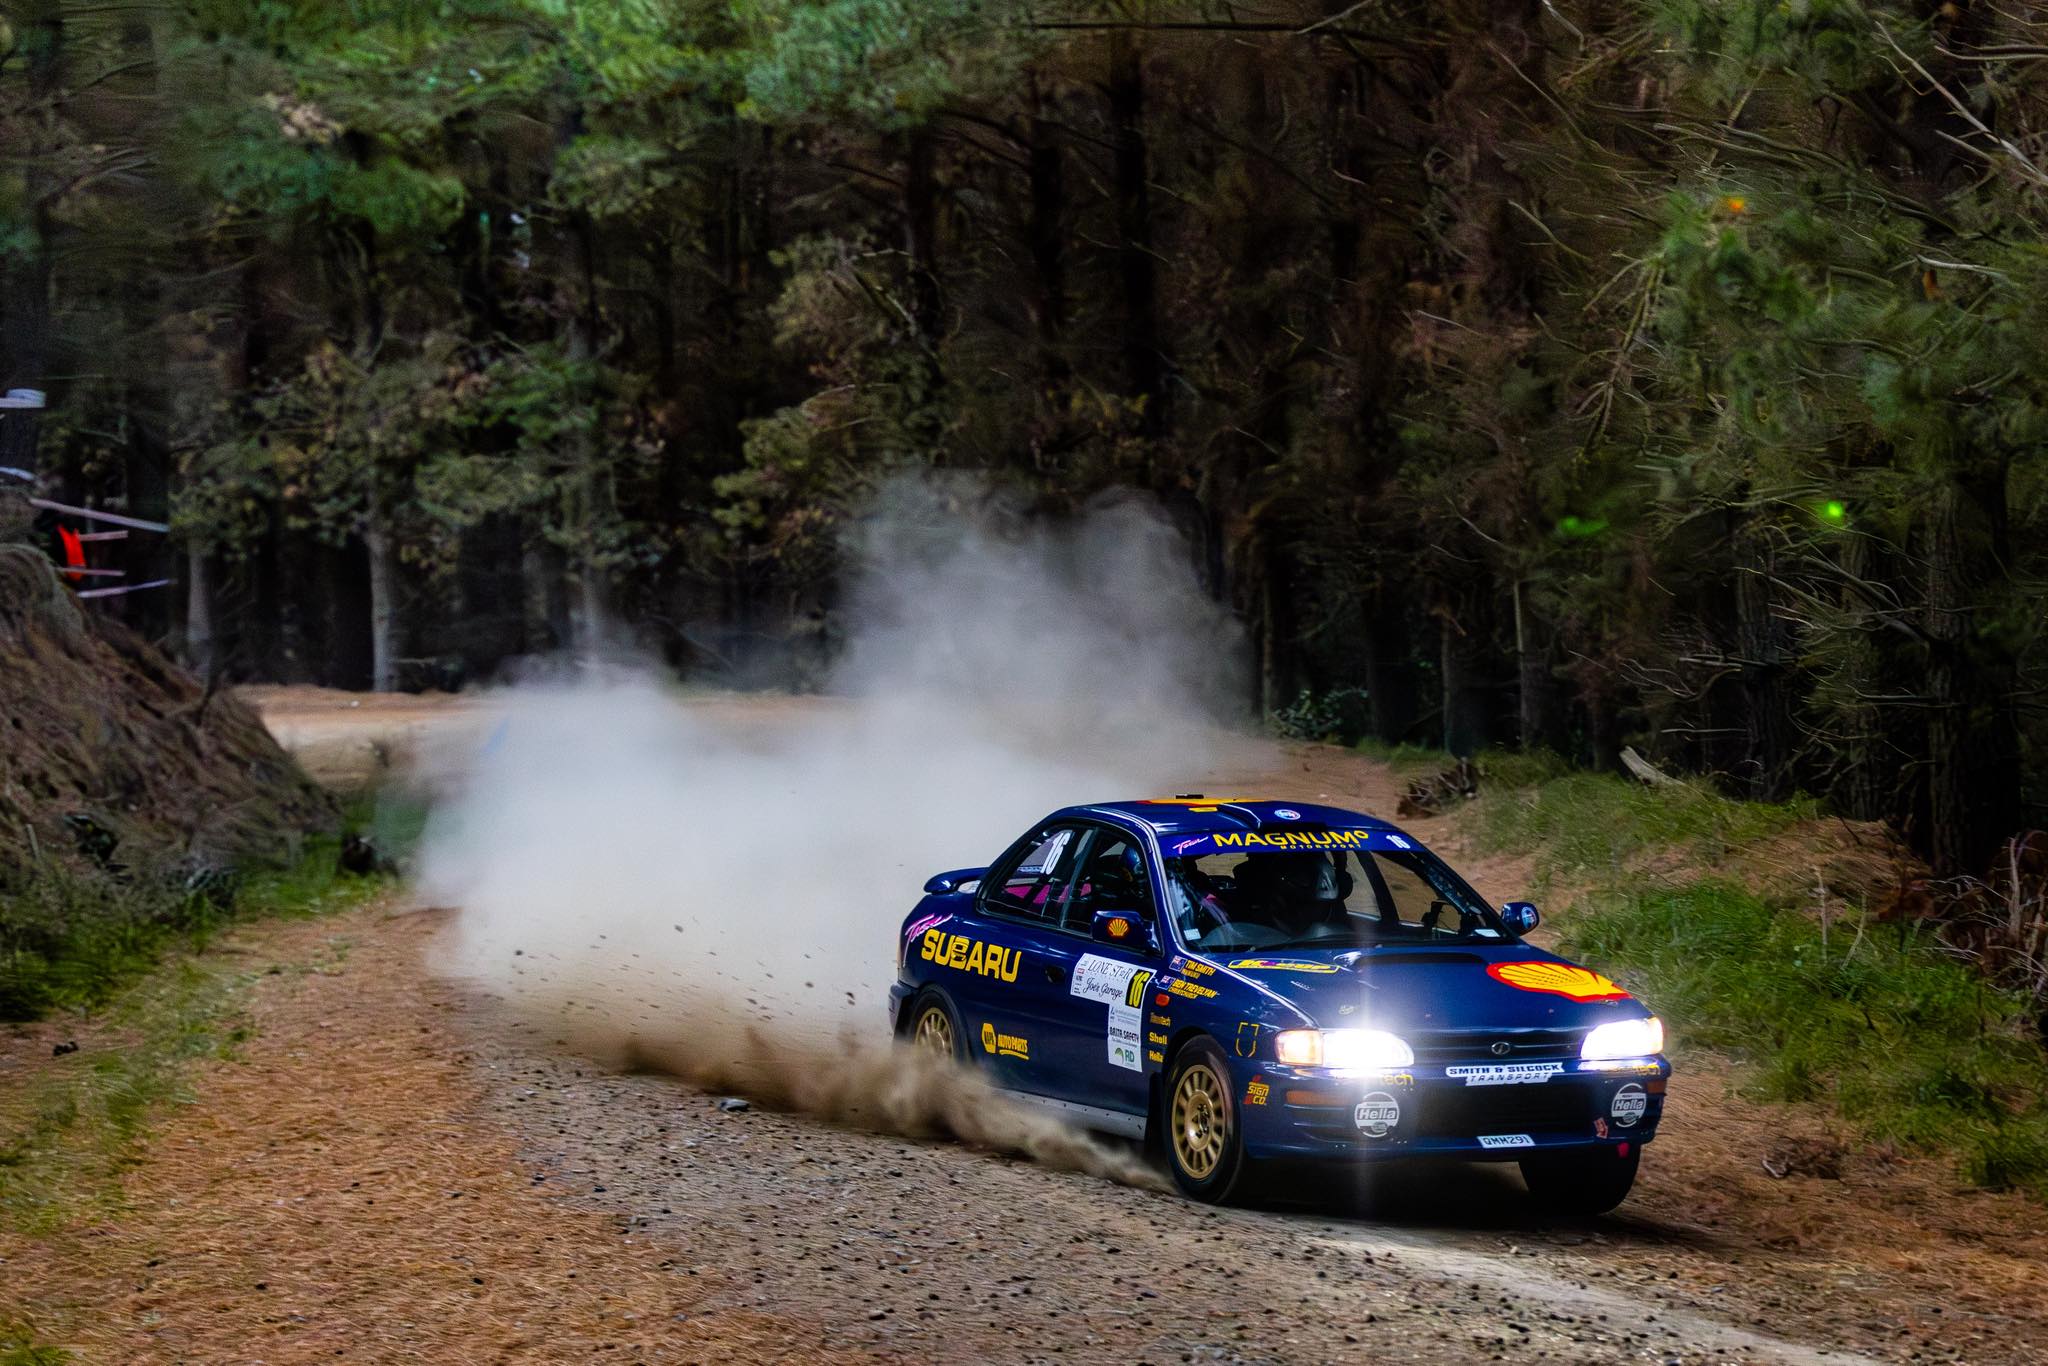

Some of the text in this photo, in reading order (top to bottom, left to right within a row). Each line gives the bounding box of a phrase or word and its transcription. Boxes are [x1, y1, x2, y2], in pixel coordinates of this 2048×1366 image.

[1040, 832, 1072, 875] 16
[921, 928, 1023, 984] SUBARU
[1195, 963, 1217, 977] SMITH
[1128, 970, 1151, 1008] 16
[1149, 1031, 1168, 1045] Shell
[1449, 1066, 1491, 1075] SMITH
[1507, 1063, 1561, 1073] SILCOCK
[1470, 1072, 1549, 1082] TRANSPORT
[1614, 1099, 1644, 1111] Hella
[1359, 1108, 1396, 1120] Hella
